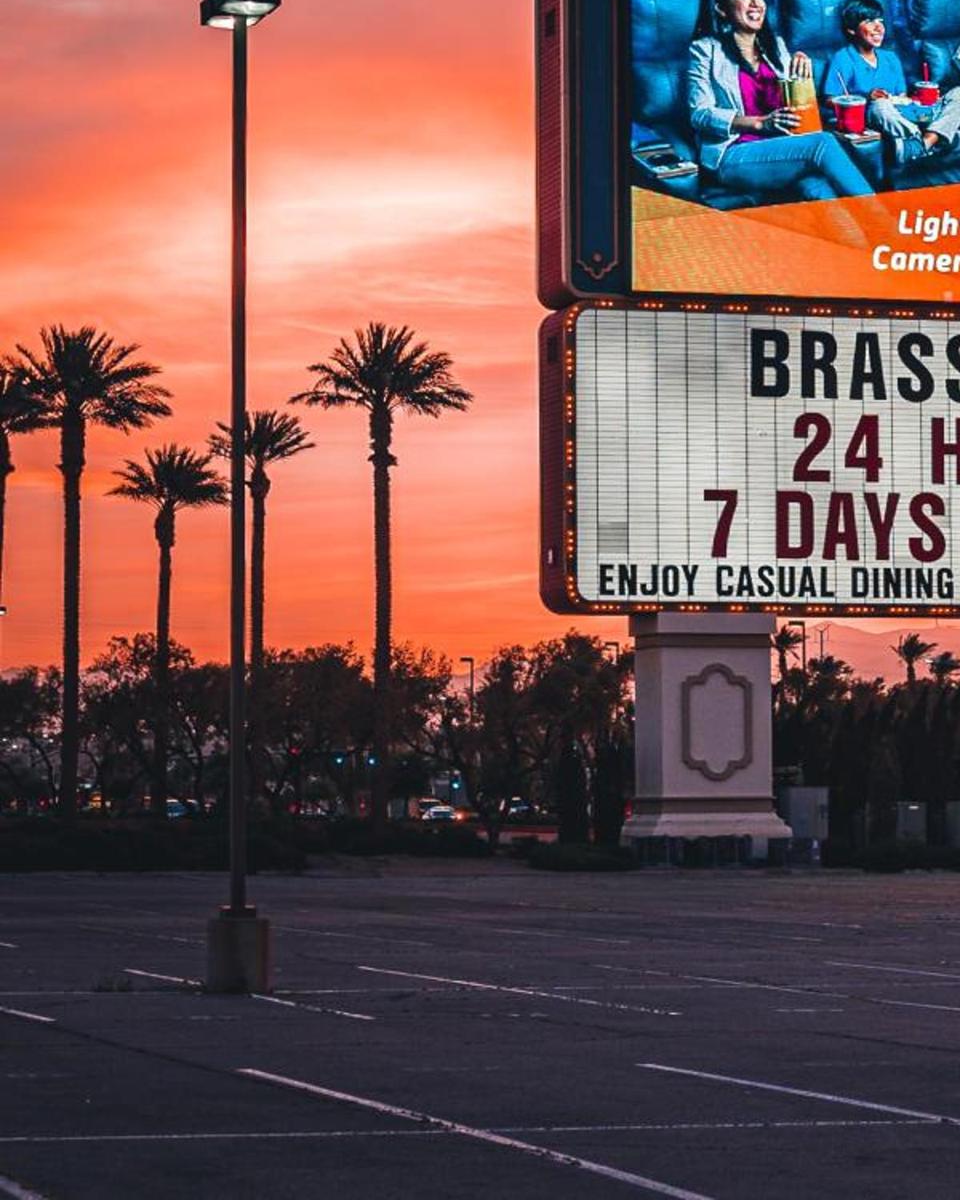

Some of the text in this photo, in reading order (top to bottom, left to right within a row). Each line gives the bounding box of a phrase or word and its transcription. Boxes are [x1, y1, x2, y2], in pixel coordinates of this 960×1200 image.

[792, 412, 883, 483] 24
[703, 490, 738, 558] 7
[775, 491, 947, 562] DAYS
[599, 564, 699, 597] ENJOY
[715, 567, 835, 599] CASUAL
[851, 569, 954, 600] DINING
